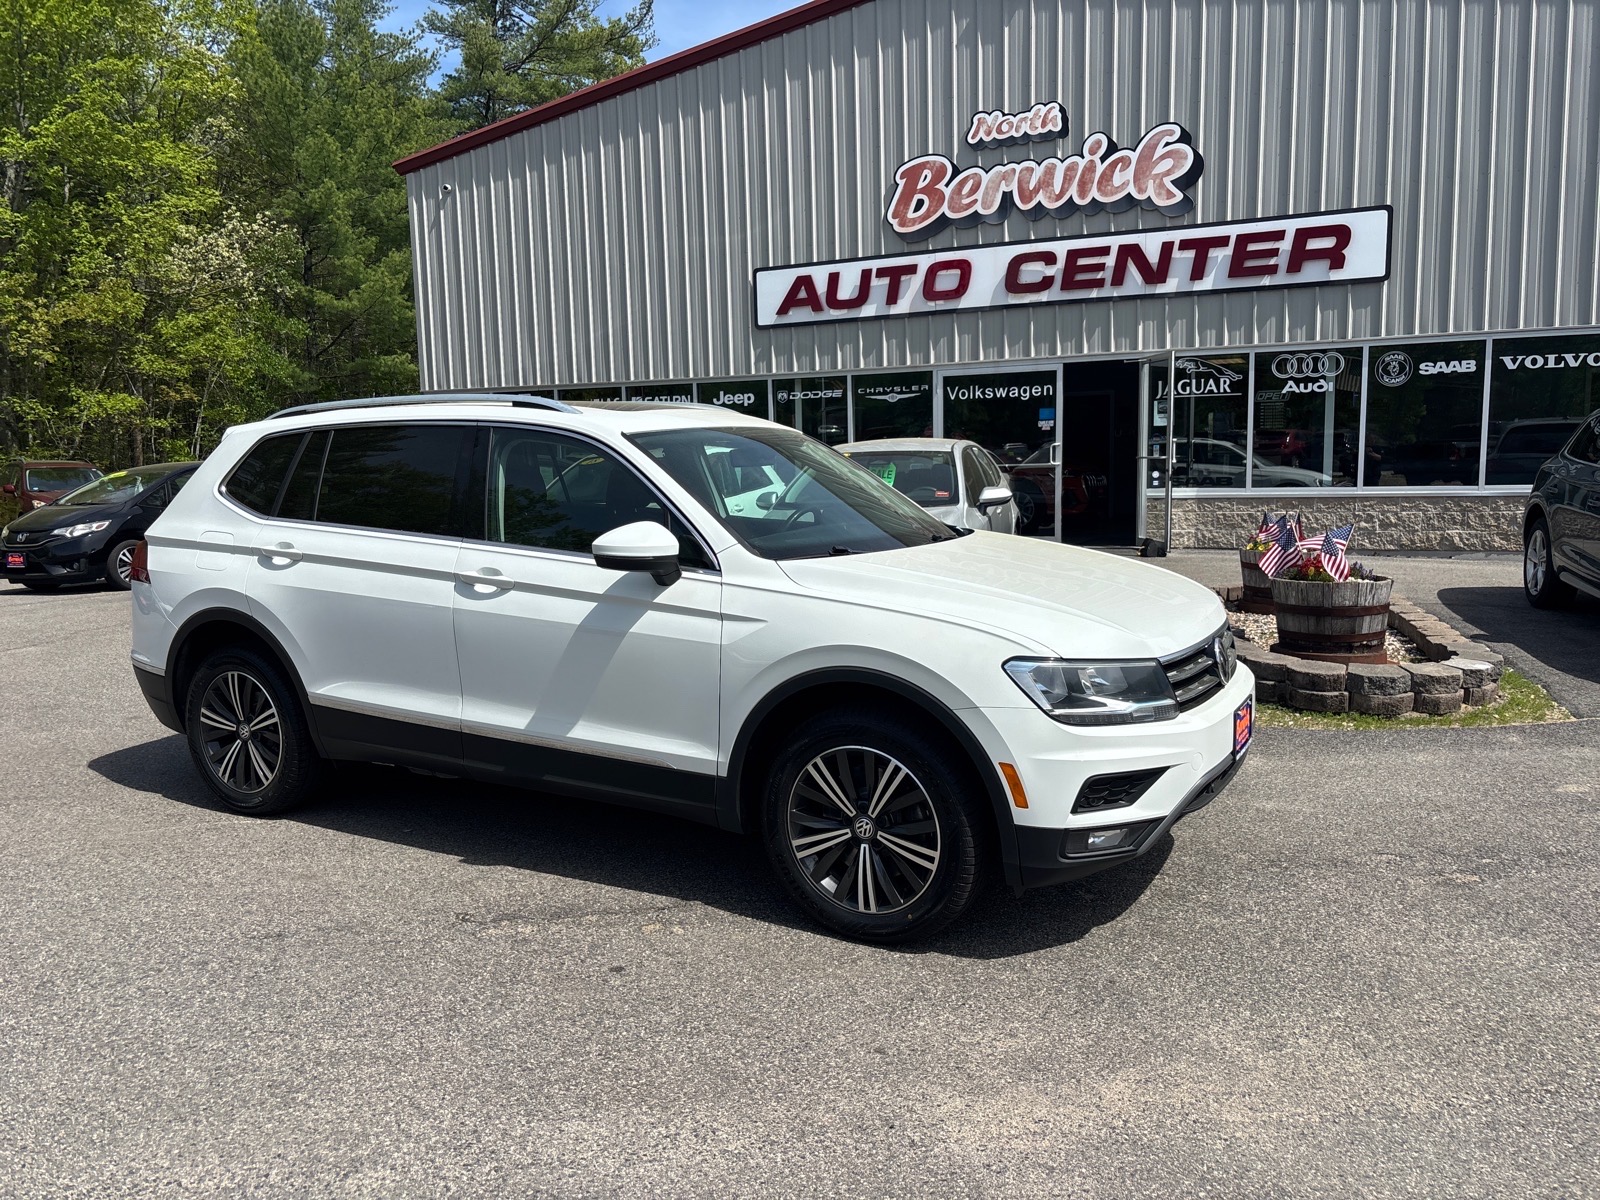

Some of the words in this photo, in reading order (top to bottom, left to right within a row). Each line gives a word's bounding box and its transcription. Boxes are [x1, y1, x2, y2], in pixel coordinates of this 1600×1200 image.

[971, 103, 1061, 140] North
[889, 126, 1191, 231] Berwick
[775, 259, 972, 316] AUTO
[1003, 223, 1352, 294] CENTER
[1419, 360, 1477, 375] SAAB
[1499, 352, 1600, 370] VOLVO
[858, 385, 929, 394] CHRYSLER
[947, 382, 1053, 401] Volkswagen
[1281, 379, 1334, 393] Audi
[713, 391, 755, 406] Jeep
[789, 389, 843, 400] DODGE
